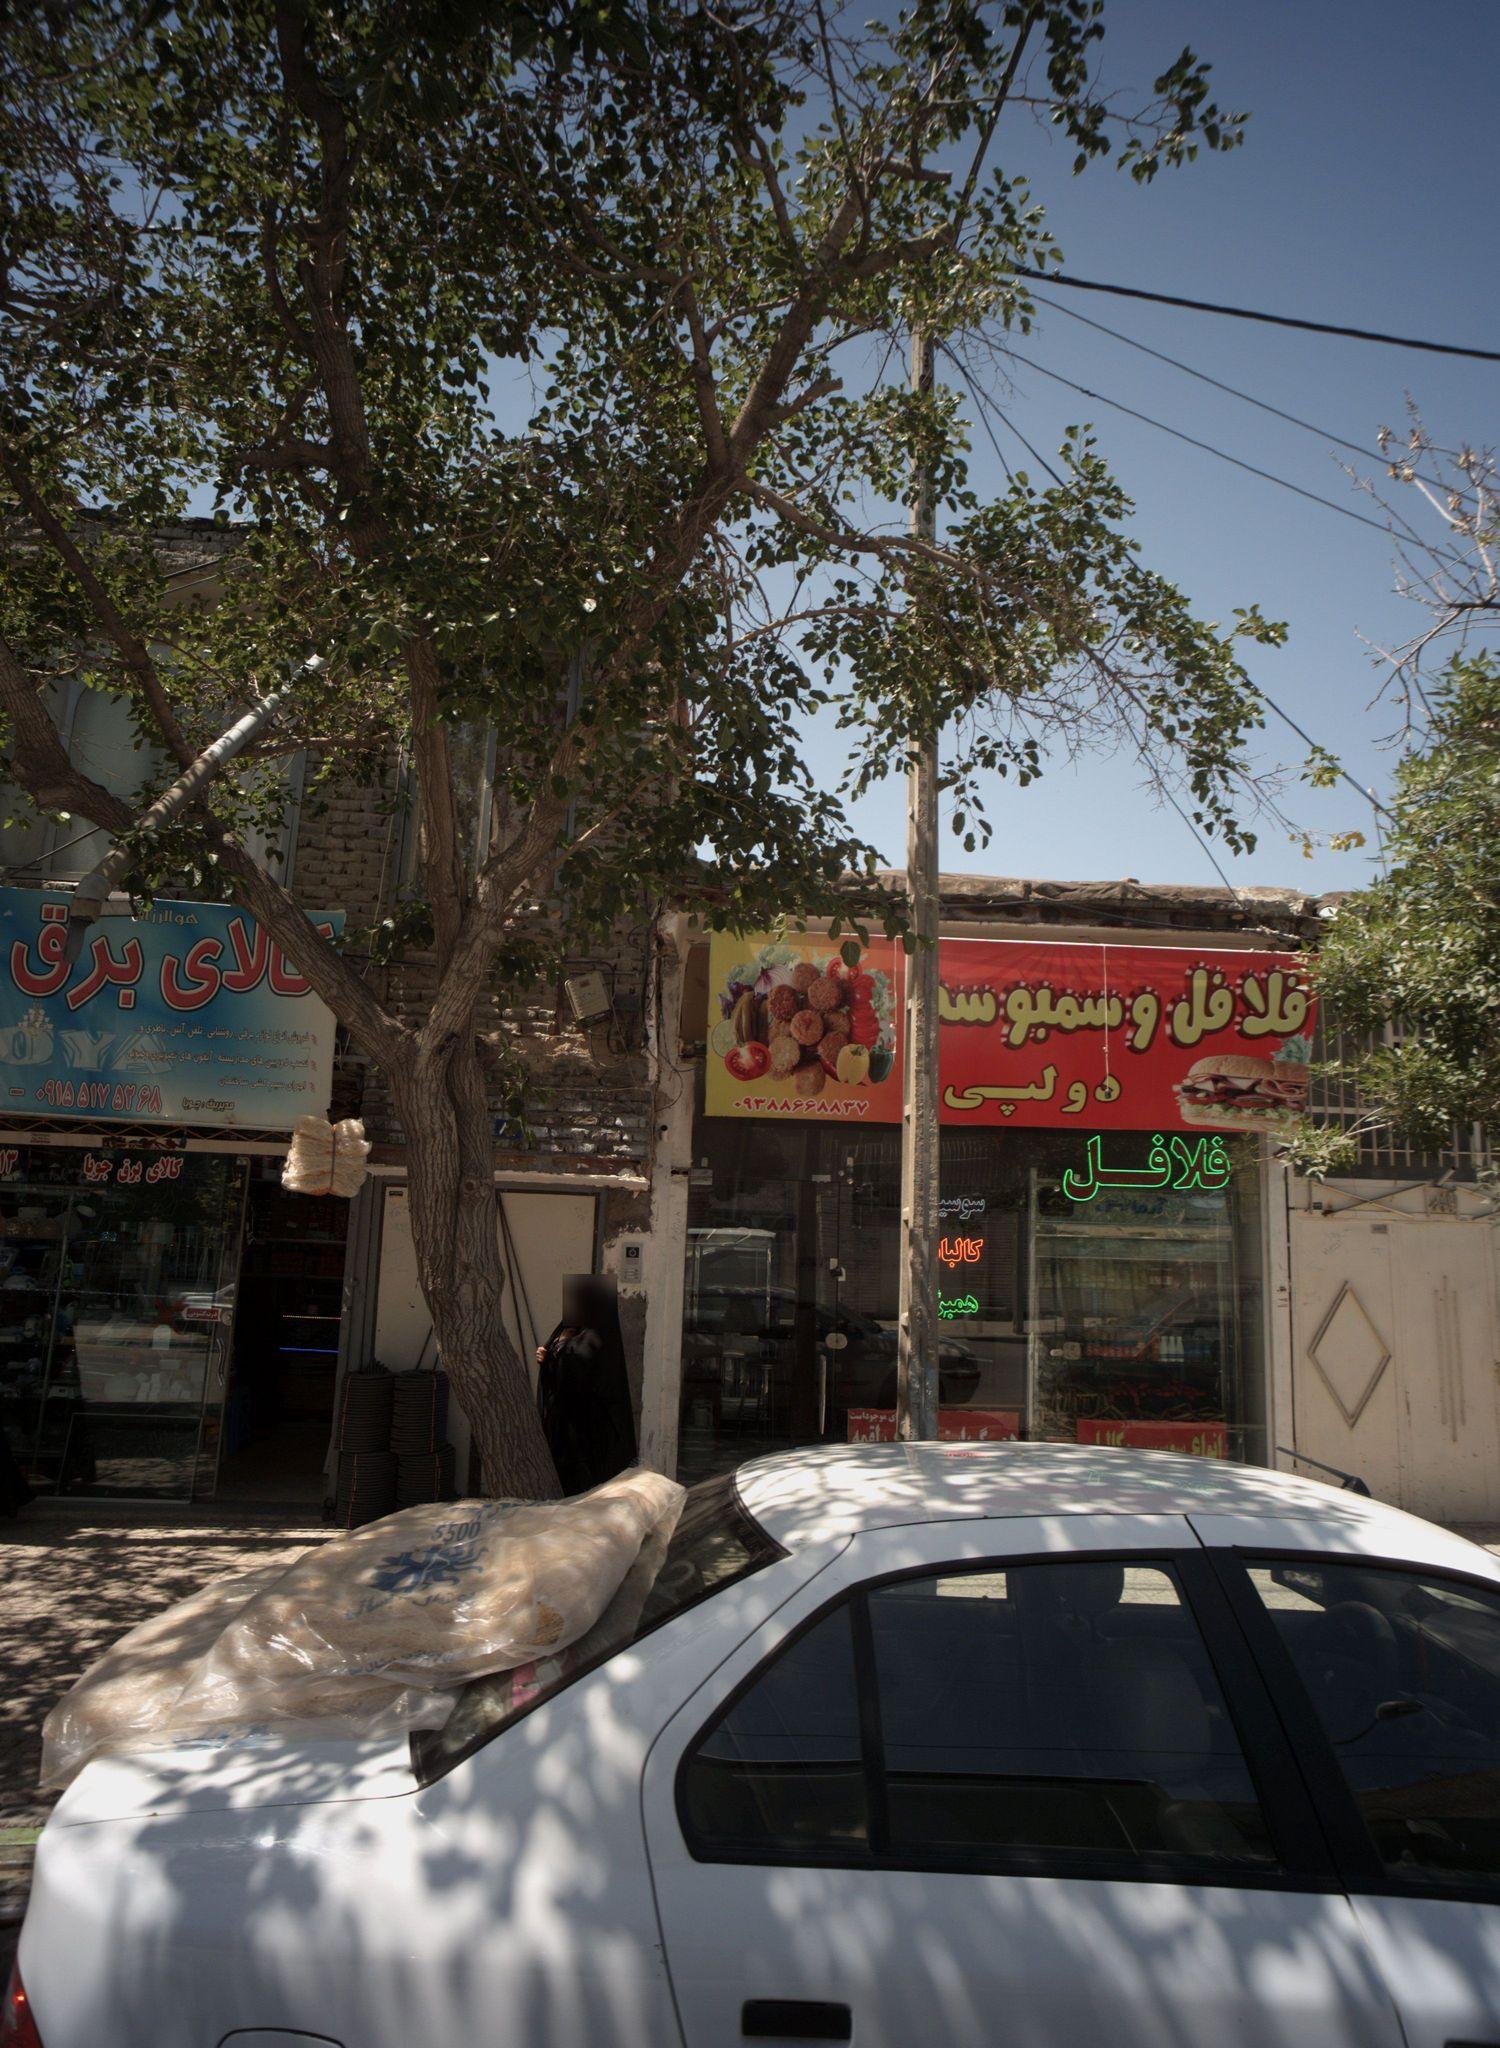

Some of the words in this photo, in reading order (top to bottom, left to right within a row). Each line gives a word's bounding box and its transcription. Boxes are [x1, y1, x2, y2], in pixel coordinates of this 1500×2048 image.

[10, 903, 143, 1011] برق
[939, 980, 1125, 1049] سمبوس
[1125, 986, 1161, 1053] و
[1168, 962, 1310, 1047] فلافل
[732, 1095, 868, 1116] ۰۹۳۸۸۶۶۸۸۳۷
[82, 1153, 113, 1182] جویا
[116, 1158, 143, 1183] برق
[145, 1156, 184, 1183] کالای
[1061, 1133, 1233, 1202] فلافل
[938, 1197, 985, 1220] سوسی
[938, 1237, 983, 1268] کالبا
[936, 1289, 979, 1320] همبر
